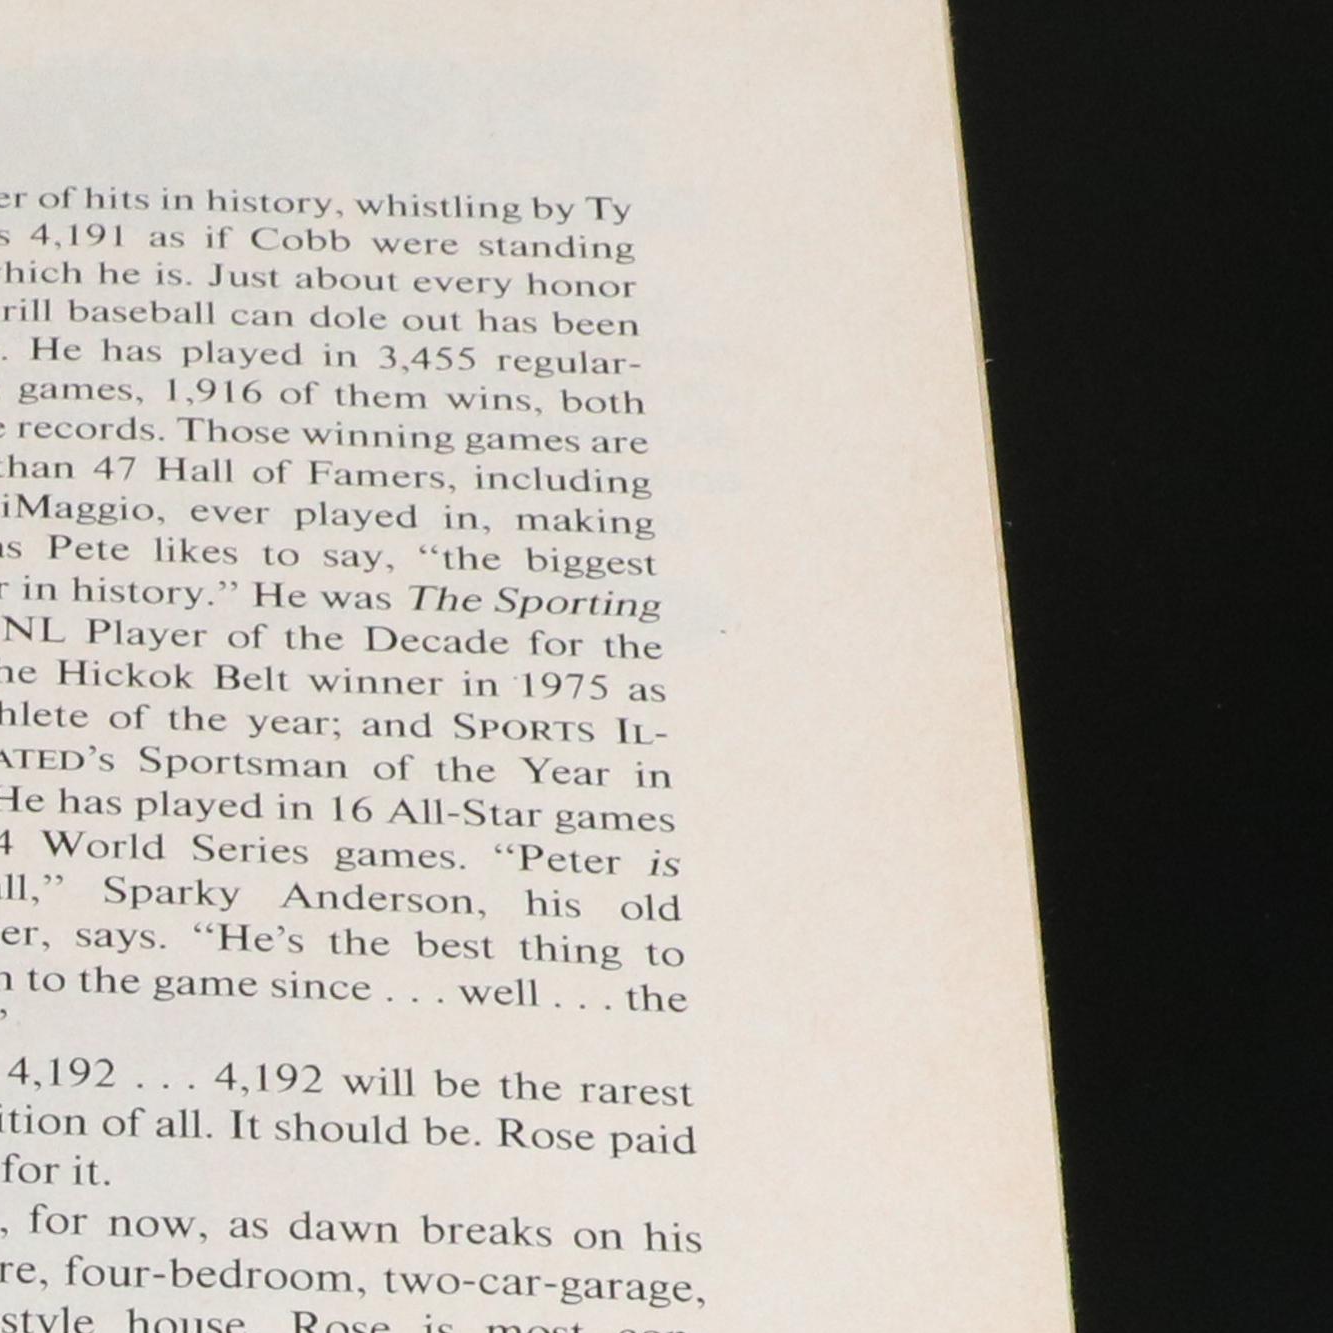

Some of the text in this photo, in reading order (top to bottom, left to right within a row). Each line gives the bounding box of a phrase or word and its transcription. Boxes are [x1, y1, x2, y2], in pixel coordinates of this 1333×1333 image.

[68, 298, 215, 325] baseball
[230, 309, 294, 328] can
[309, 304, 387, 331] dole
[402, 311, 460, 333] out
[477, 307, 538, 334] has
[552, 310, 639, 337] been
[93, 455, 136, 481] 47
[158, 456, 233, 483] Hall
[252, 459, 293, 485] of
[309, 459, 456, 494] Famers,
[475, 464, 653, 500] including
[1, 615, 66, 643] NL
[87, 618, 208, 652] Player
[227, 622, 269, 649] of
[284, 624, 344, 651] the
[365, 625, 509, 655] Decade
[528, 629, 584, 657] for
[603, 632, 663, 661] the
[102, 1106, 147, 1138] of
[155, 1108, 213, 1139] all.
[230, 1109, 261, 1141] It
[274, 1111, 410, 1146] should
[423, 1115, 481, 1147] be.
[497, 1117, 595, 1152] Rose
[609, 1124, 698, 1159] paid
